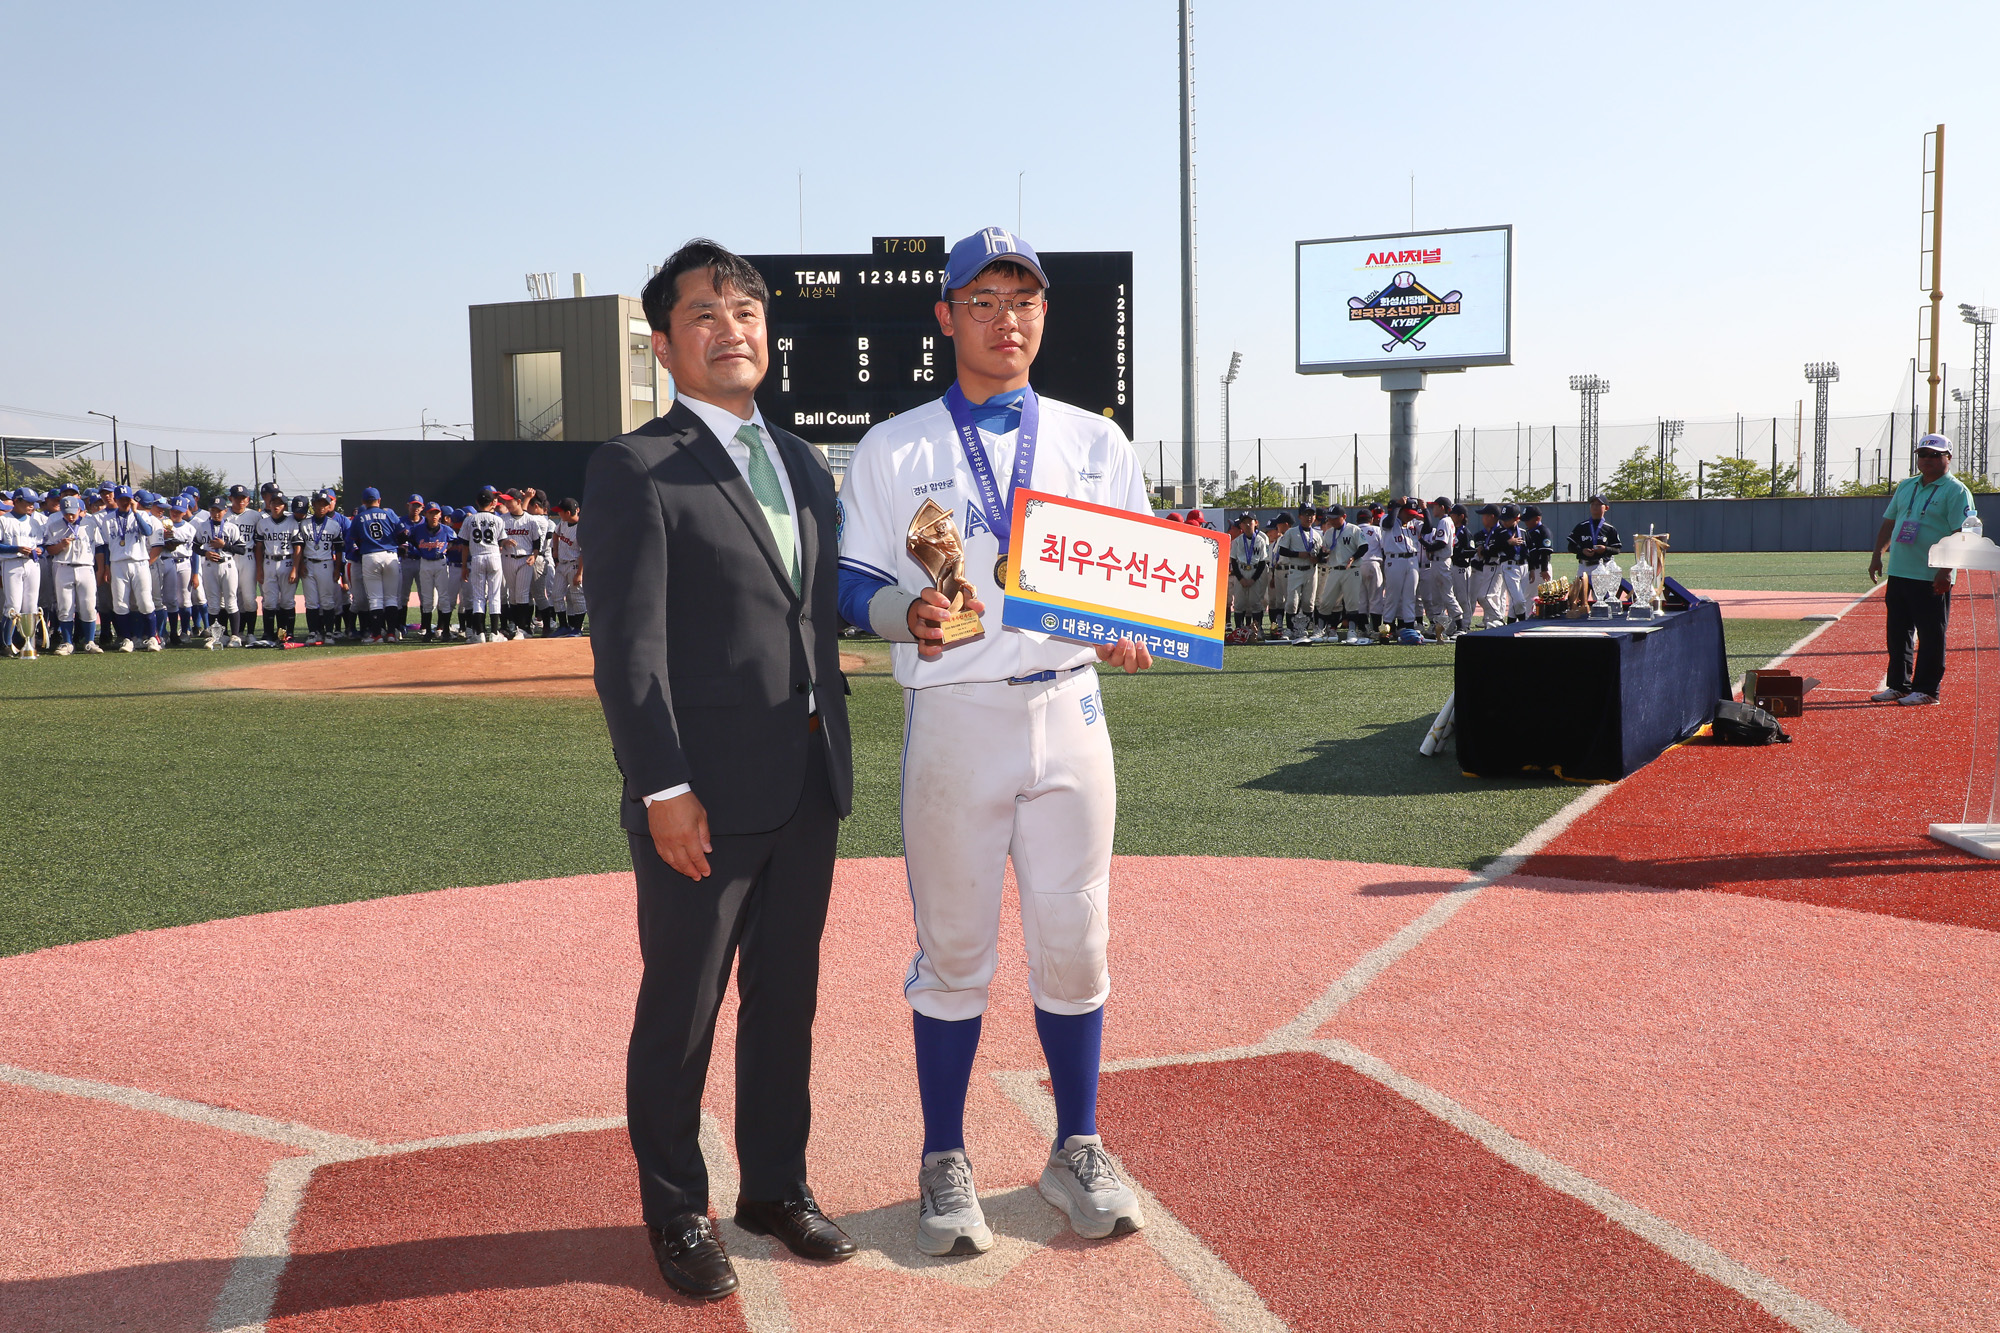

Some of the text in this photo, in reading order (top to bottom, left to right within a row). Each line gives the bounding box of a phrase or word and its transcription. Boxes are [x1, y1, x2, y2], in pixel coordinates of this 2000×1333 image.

[982, 227, 1017, 256] H
[1365, 248, 1441, 265] 시사저널
[794, 271, 840, 284] TEAM
[858, 270, 866, 284] 1
[871, 270, 880, 284] 2
[884, 270, 894, 284] 3
[898, 270, 907, 284] 4
[912, 270, 920, 284] 5
[925, 270, 934, 284] 6
[798, 286, 836, 298] 시상식
[1118, 284, 1124, 296] 1
[1364, 289, 1380, 302] 2024
[1117, 298, 1125, 310] 2
[1380, 294, 1428, 306] 화성시장배
[1350, 302, 1460, 319] 전국유소년야구대회
[1117, 311, 1125, 323] 3
[1390, 318, 1421, 328] KYBF
[1117, 324, 1125, 337] 4
[777, 338, 792, 350] CH
[858, 338, 869, 350] B
[922, 336, 934, 350] H
[1117, 338, 1126, 350] 5
[858, 353, 869, 366] S
[923, 352, 934, 366] E
[1117, 352, 1126, 364] 6
[913, 369, 934, 382] FC
[1117, 366, 1126, 378] 7
[1118, 380, 1126, 392] 8
[1118, 393, 1126, 405] 9
[794, 412, 870, 425] Ball Count
[120, 486, 128, 494] H
[913, 484, 928, 496] 경남
[991, 505, 1002, 520] 2024
[369, 522, 384, 540] 8
[472, 528, 494, 544] 99
[281, 542, 290, 550] 22
[1342, 536, 1352, 545] W
[1040, 534, 1204, 600] 최우수선수상
[1062, 618, 1190, 658] 대한유소년야구연맹
[937, 1157, 956, 1166] HOKA
